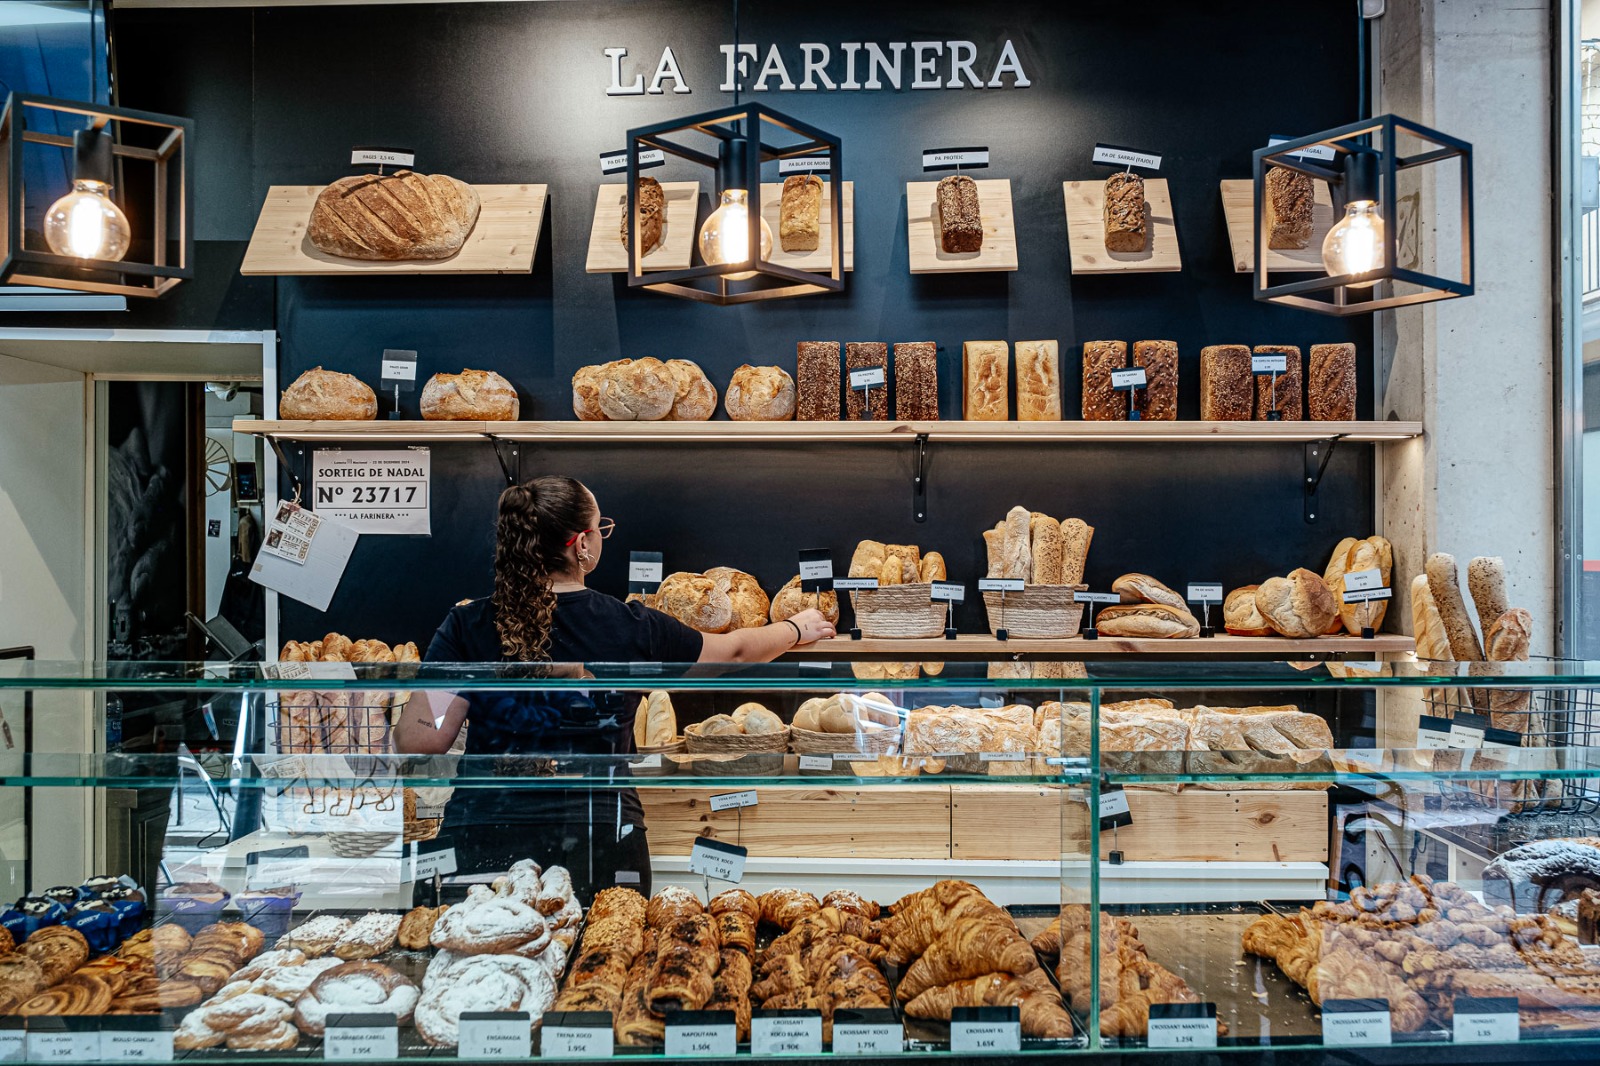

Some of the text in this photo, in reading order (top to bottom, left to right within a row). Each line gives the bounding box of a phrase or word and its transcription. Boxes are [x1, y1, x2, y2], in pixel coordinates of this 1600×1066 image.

[604, 39, 1032, 96] LA FARINERA
[318, 468, 425, 477] SORTEIG DE NADAL
[352, 487, 417, 504] 23717
[715, 866, 726, 874] 1.05
[1331, 1018, 1361, 1026] CROISSANT
[692, 1044, 711, 1052] 1.50€
[857, 1041, 876, 1049] 1.75€
[976, 1040, 995, 1048] 1.65€
[483, 1047, 502, 1055] 1.75€
